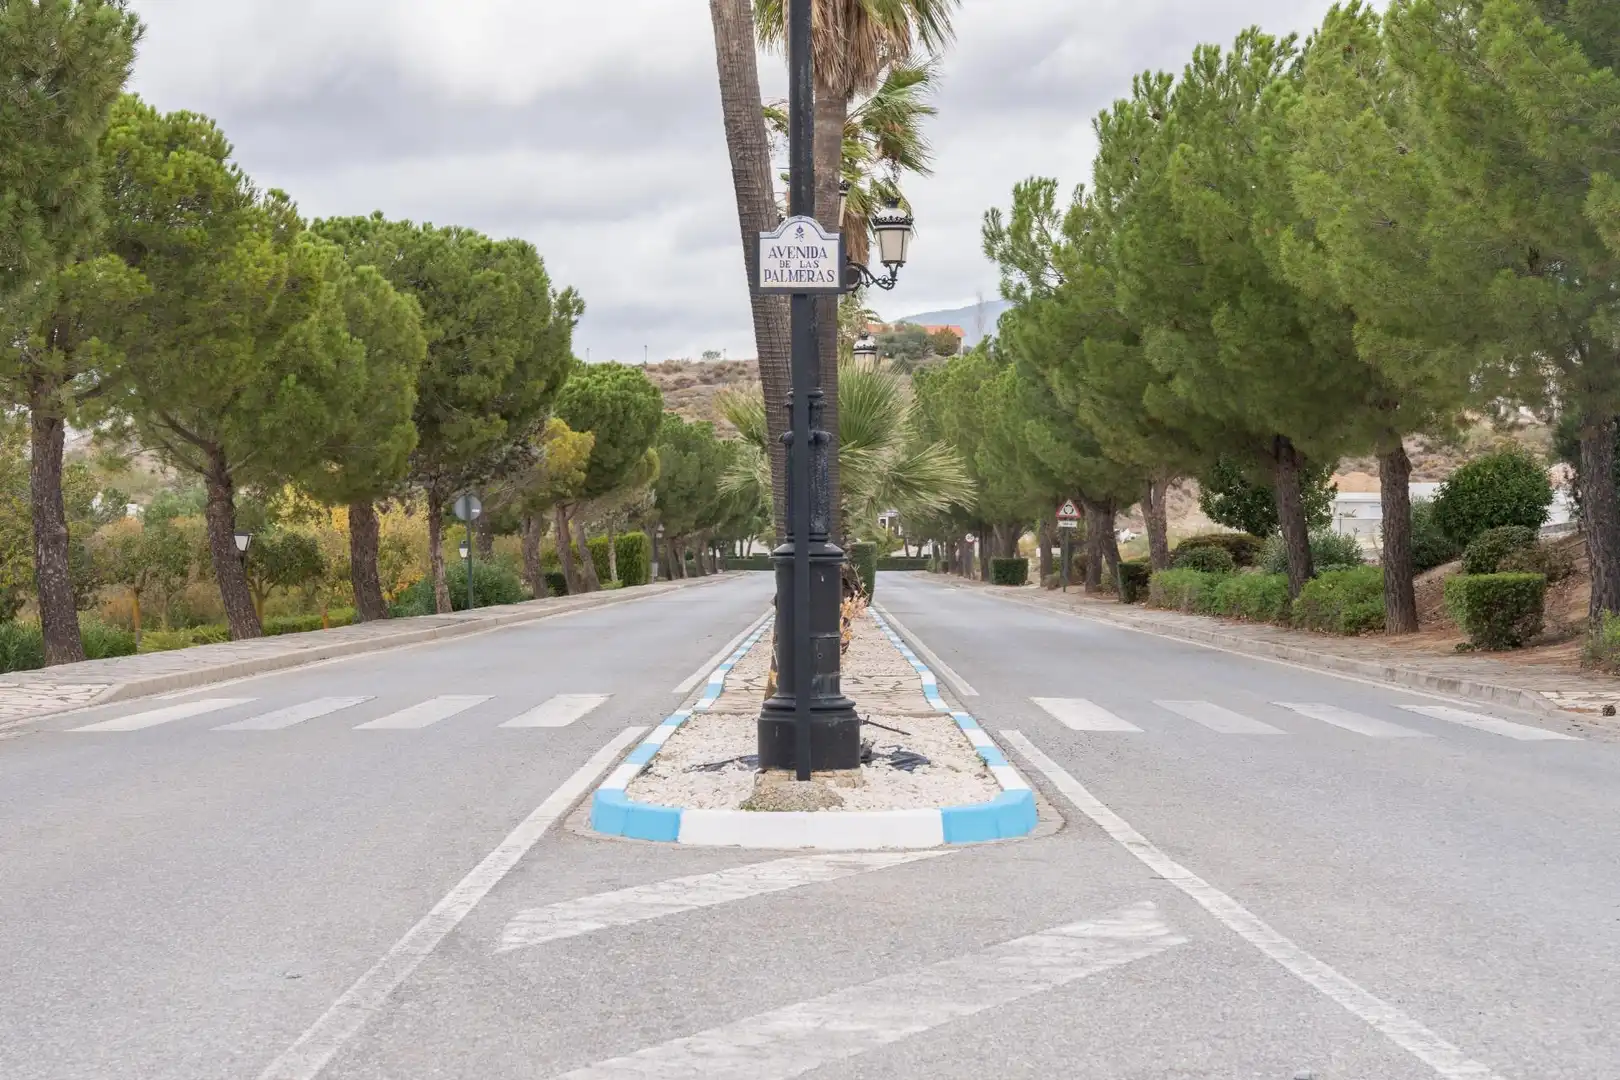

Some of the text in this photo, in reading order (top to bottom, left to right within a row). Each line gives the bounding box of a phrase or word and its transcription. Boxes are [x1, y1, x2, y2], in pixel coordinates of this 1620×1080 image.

[768, 246, 828, 259] AVENIDA
[780, 260, 819, 268] DE LAS
[764, 269, 835, 282] PALMERAS
